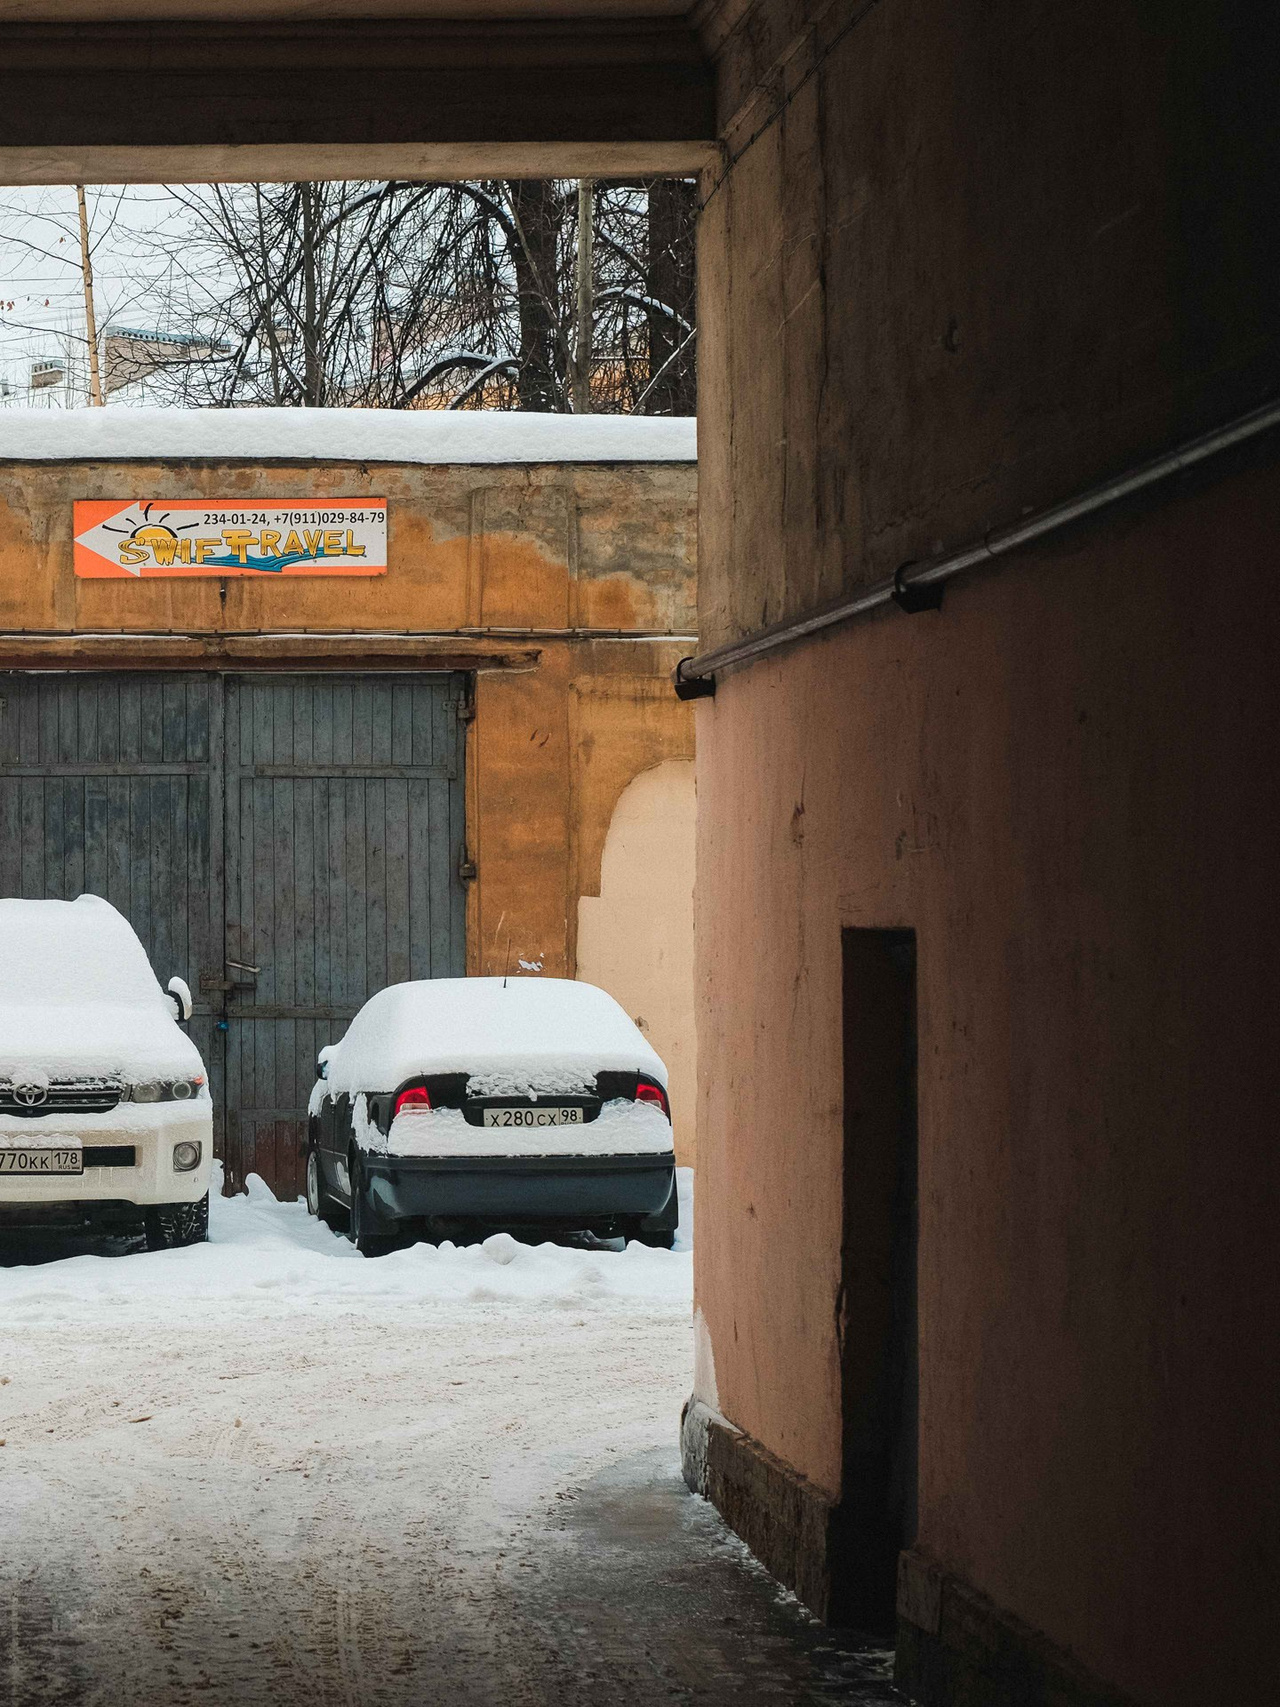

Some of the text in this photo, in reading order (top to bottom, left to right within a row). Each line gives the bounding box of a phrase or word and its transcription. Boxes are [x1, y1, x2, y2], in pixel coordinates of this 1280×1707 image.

[204, 511, 385, 526] 234-01-24, +7(911)029-84-79
[561, 1109, 578, 1122] 98
[54, 1152, 78, 1165] 178
